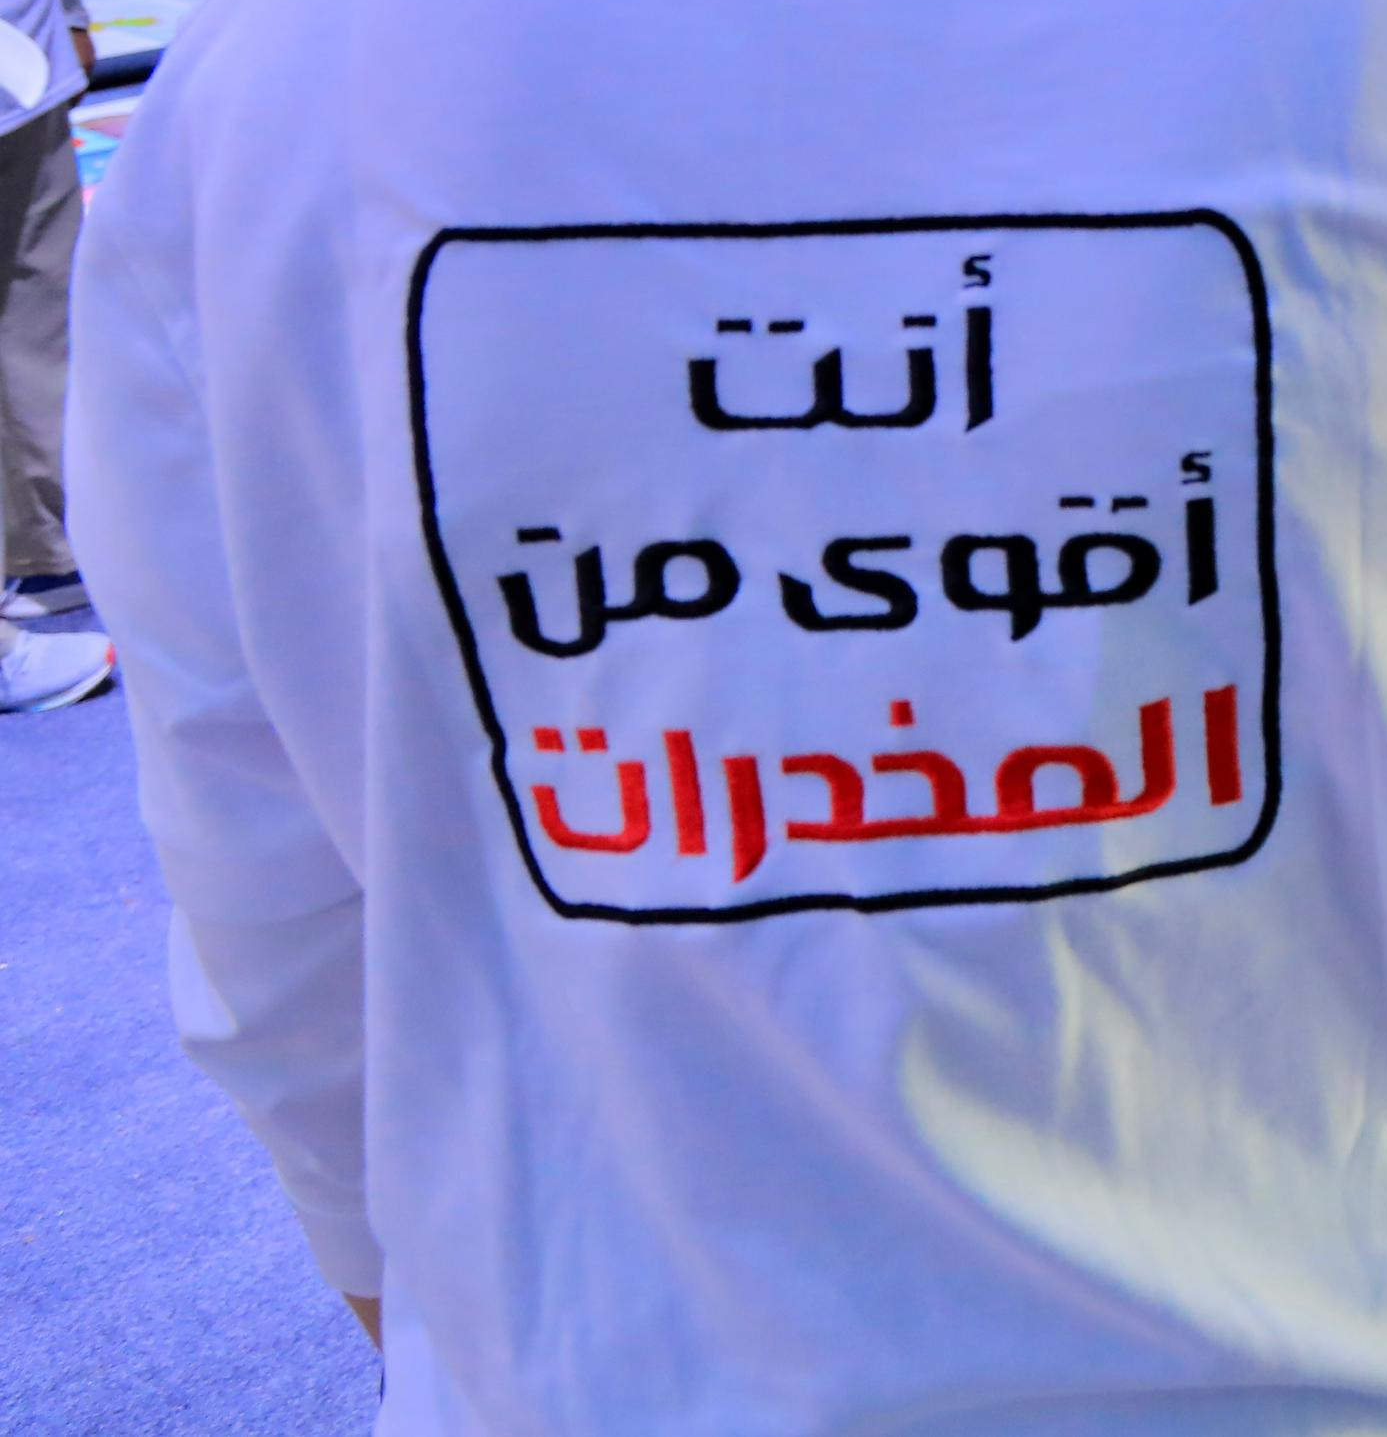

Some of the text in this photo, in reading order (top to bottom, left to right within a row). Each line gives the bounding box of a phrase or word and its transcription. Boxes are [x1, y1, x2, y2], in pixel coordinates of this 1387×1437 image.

[687, 253, 994, 433] أنت
[497, 449, 1219, 659] أقوى من
[531, 684, 1243, 884] المخدرات
